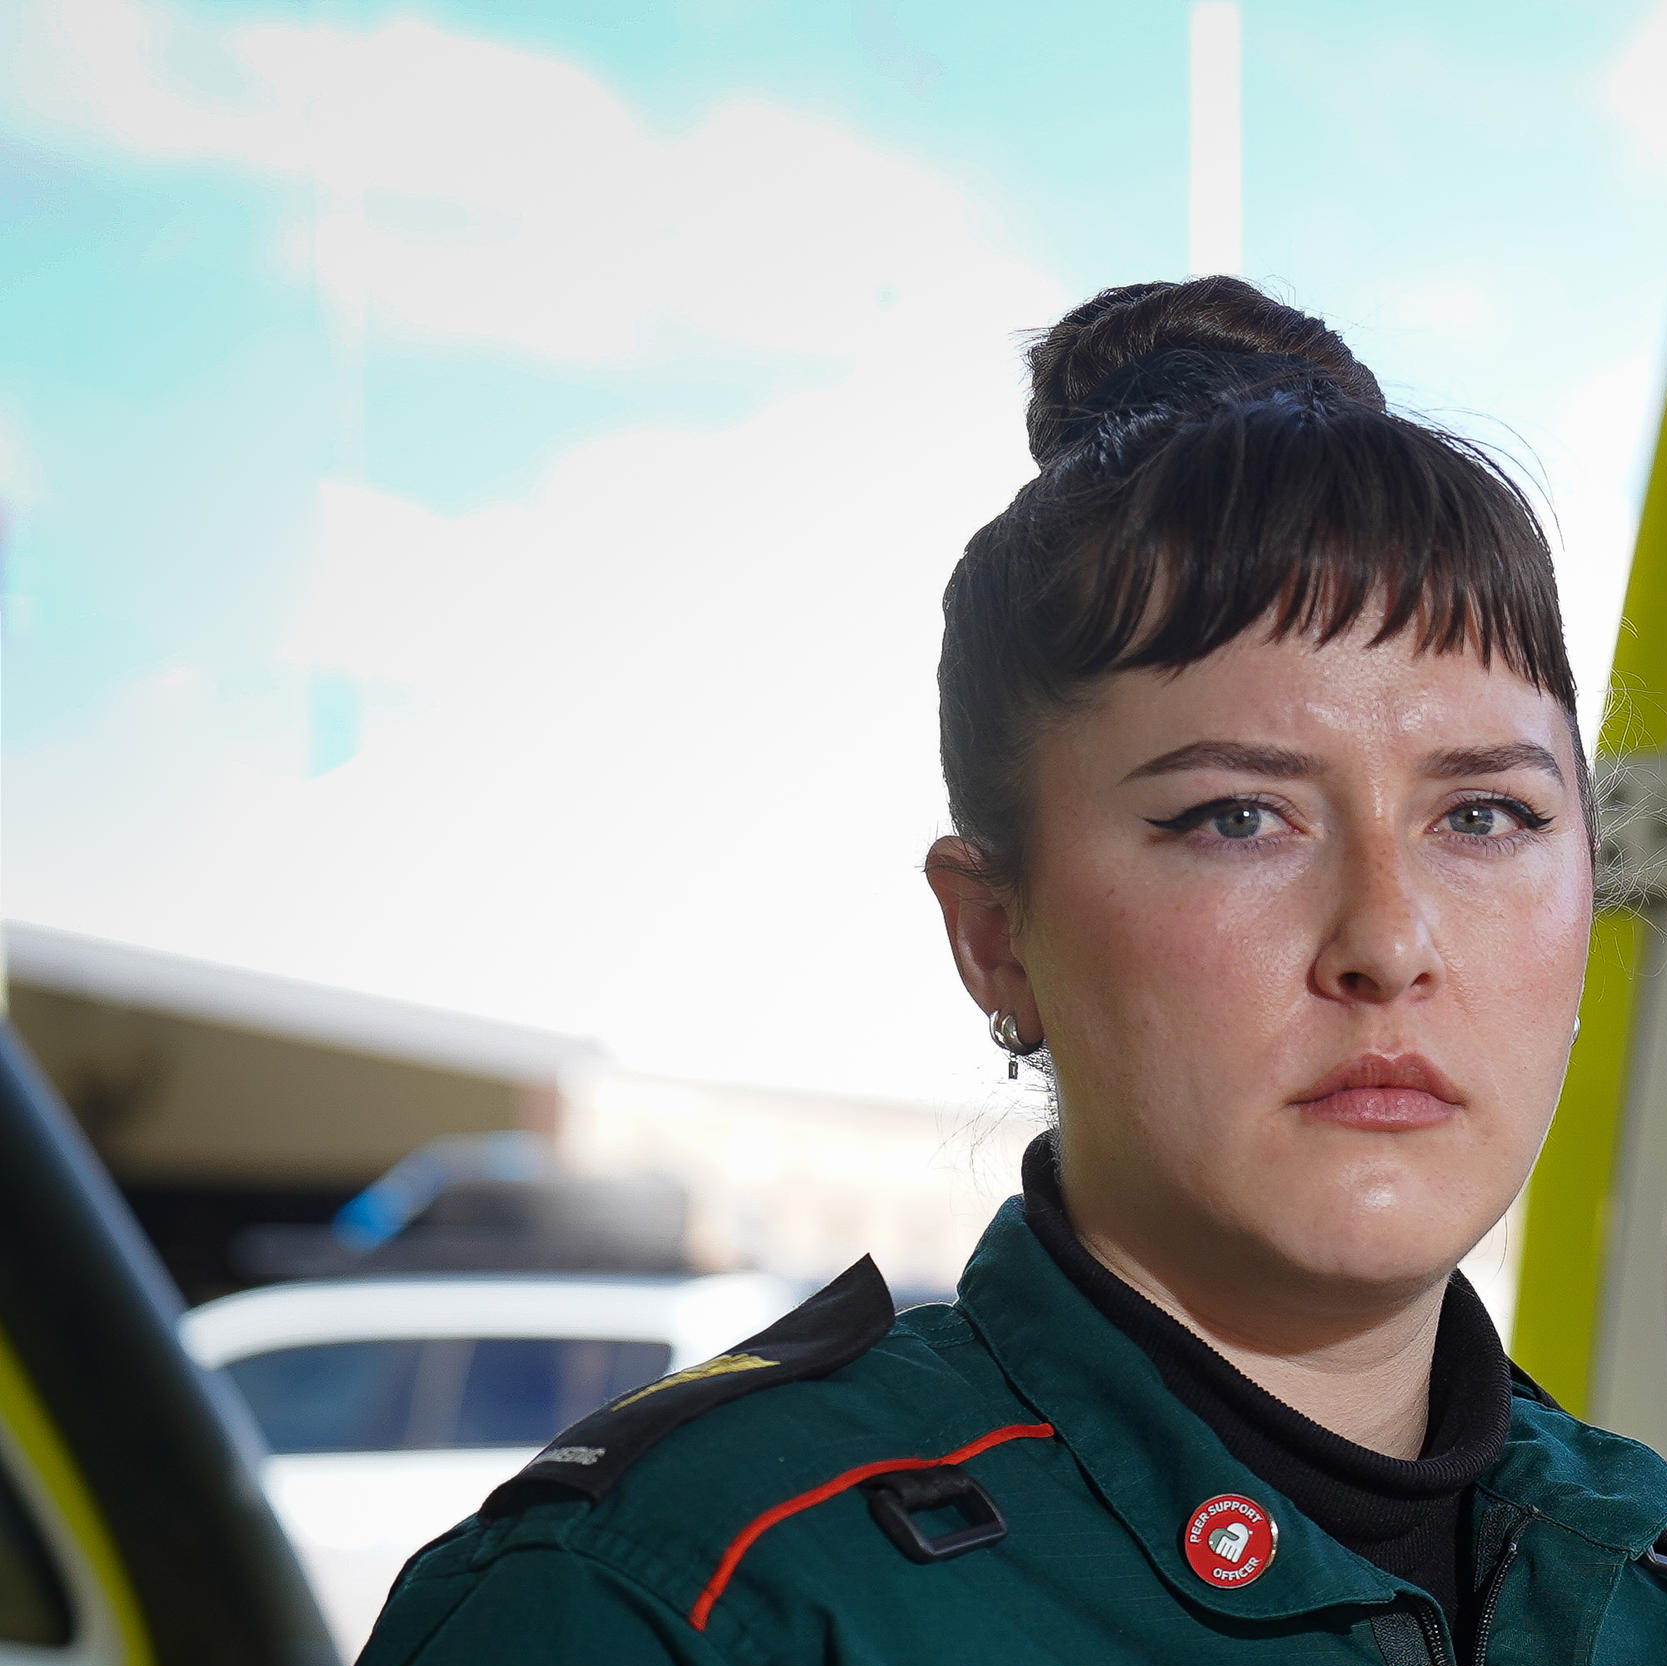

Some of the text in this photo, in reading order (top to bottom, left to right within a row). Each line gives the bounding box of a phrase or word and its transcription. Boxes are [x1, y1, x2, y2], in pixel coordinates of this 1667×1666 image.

[1190, 1501, 1263, 1543] PEER SUPPORT
[1213, 1557, 1260, 1580] OFFICER
